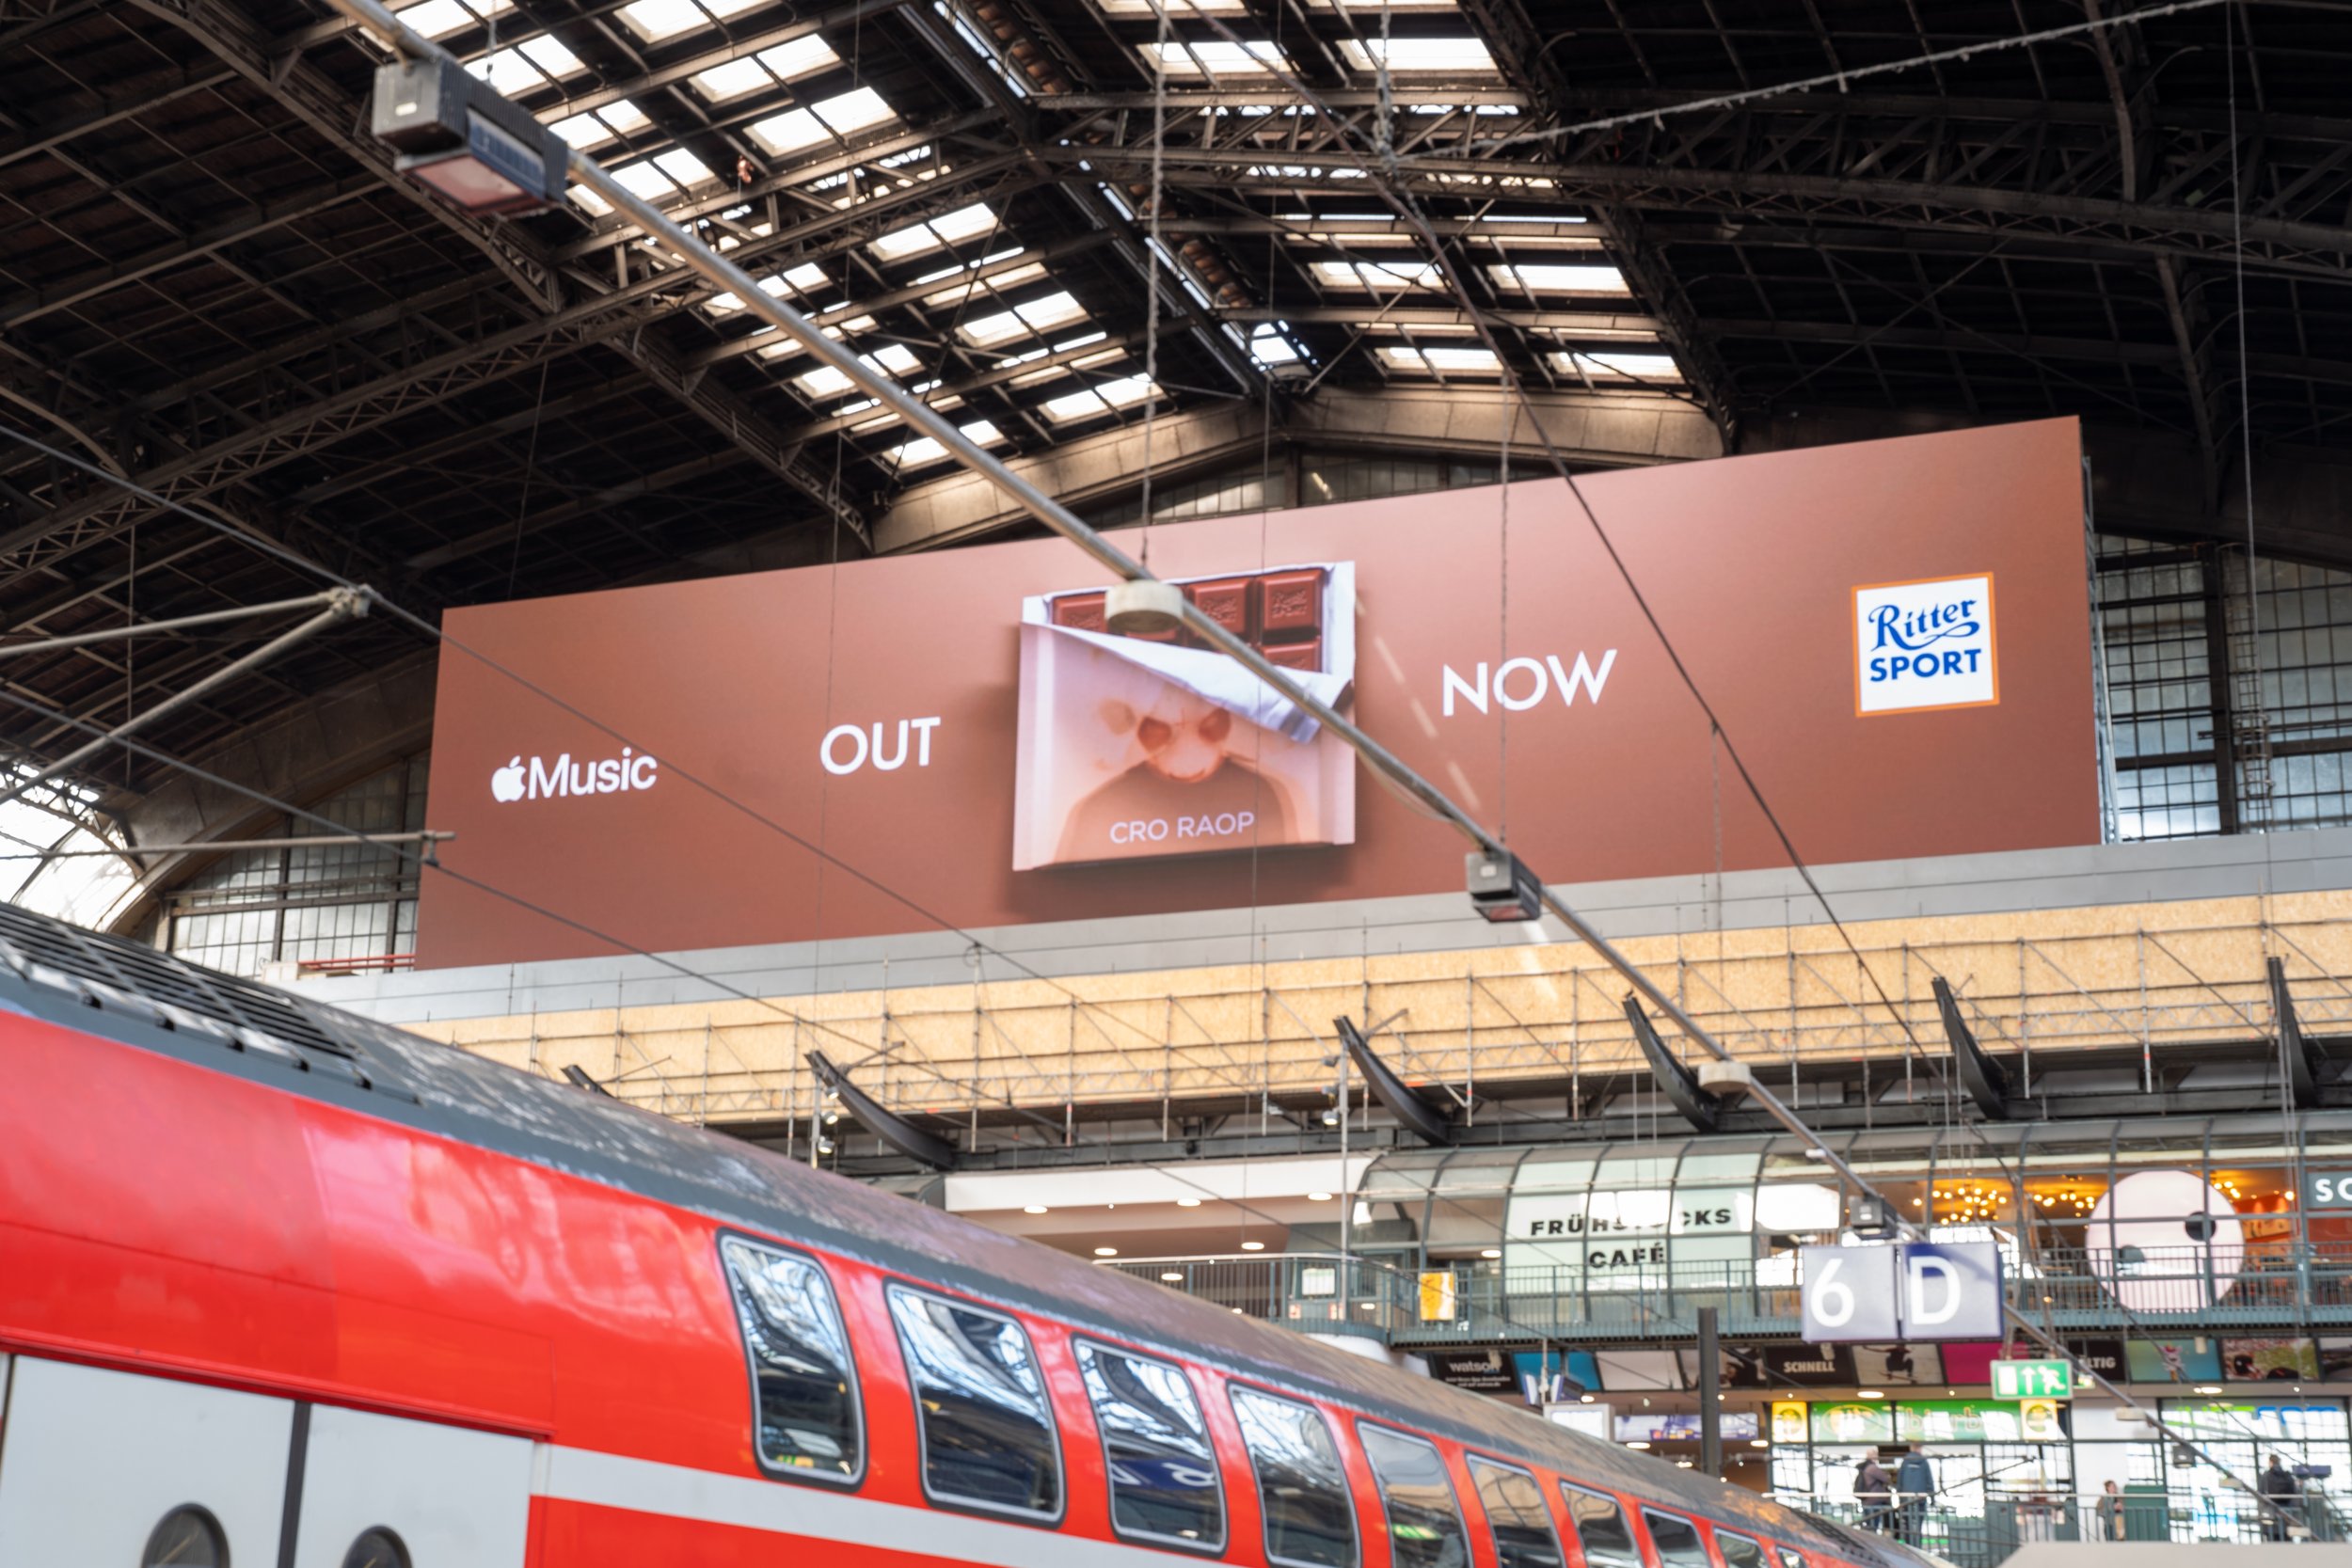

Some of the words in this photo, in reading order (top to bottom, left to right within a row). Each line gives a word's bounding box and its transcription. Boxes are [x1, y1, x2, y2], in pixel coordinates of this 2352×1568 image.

[1868, 599, 1980, 652] Ritter
[1442, 648, 1618, 717] NOW
[1869, 648, 1982, 682] SPORT
[819, 716, 941, 775] OUT
[528, 747, 658, 800] Music
[1109, 818, 1169, 844] CRO
[1177, 811, 1255, 839] RAOP
[1531, 1208, 1732, 1236] FRÜHKS
[1589, 1242, 1664, 1269] CAFÉ
[1809, 1258, 1855, 1328] 6
[1909, 1255, 1962, 1325] D
[1783, 1359, 1836, 1373] SCHNELL
